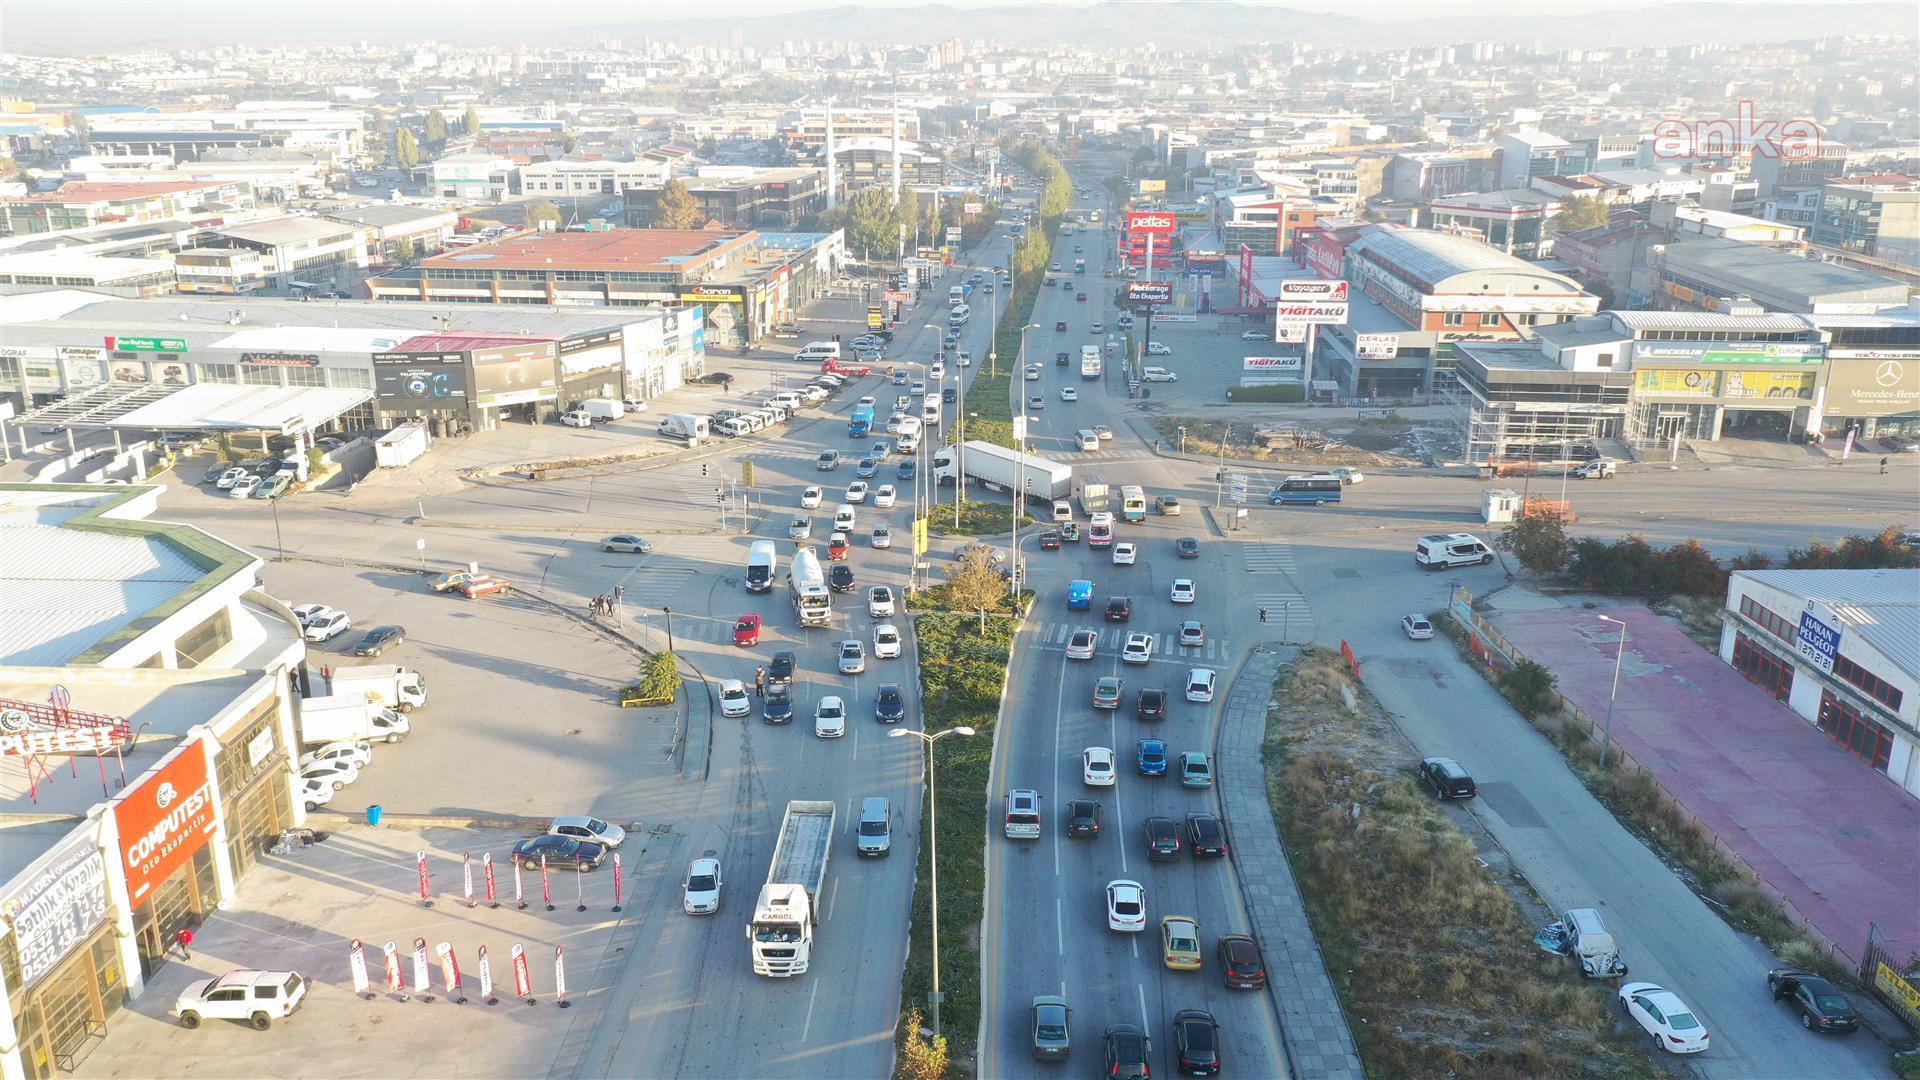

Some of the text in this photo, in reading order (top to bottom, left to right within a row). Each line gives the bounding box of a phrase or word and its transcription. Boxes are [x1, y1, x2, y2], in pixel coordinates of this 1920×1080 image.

[1130, 215, 1171, 229] petlas
[1288, 284, 1327, 293] Voyager
[1653, 348, 1703, 356] MICHELIN
[1800, 626, 1835, 655] PEUGEOT
[1805, 616, 1833, 641] HAKAN
[127, 781, 212, 868] COMPUTEST
[142, 856, 160, 876] Oto
[20, 868, 57, 908] MADEN
[16, 894, 57, 938] Satılık
[20, 929, 53, 965] 0532
[22, 946, 57, 982] 0532
